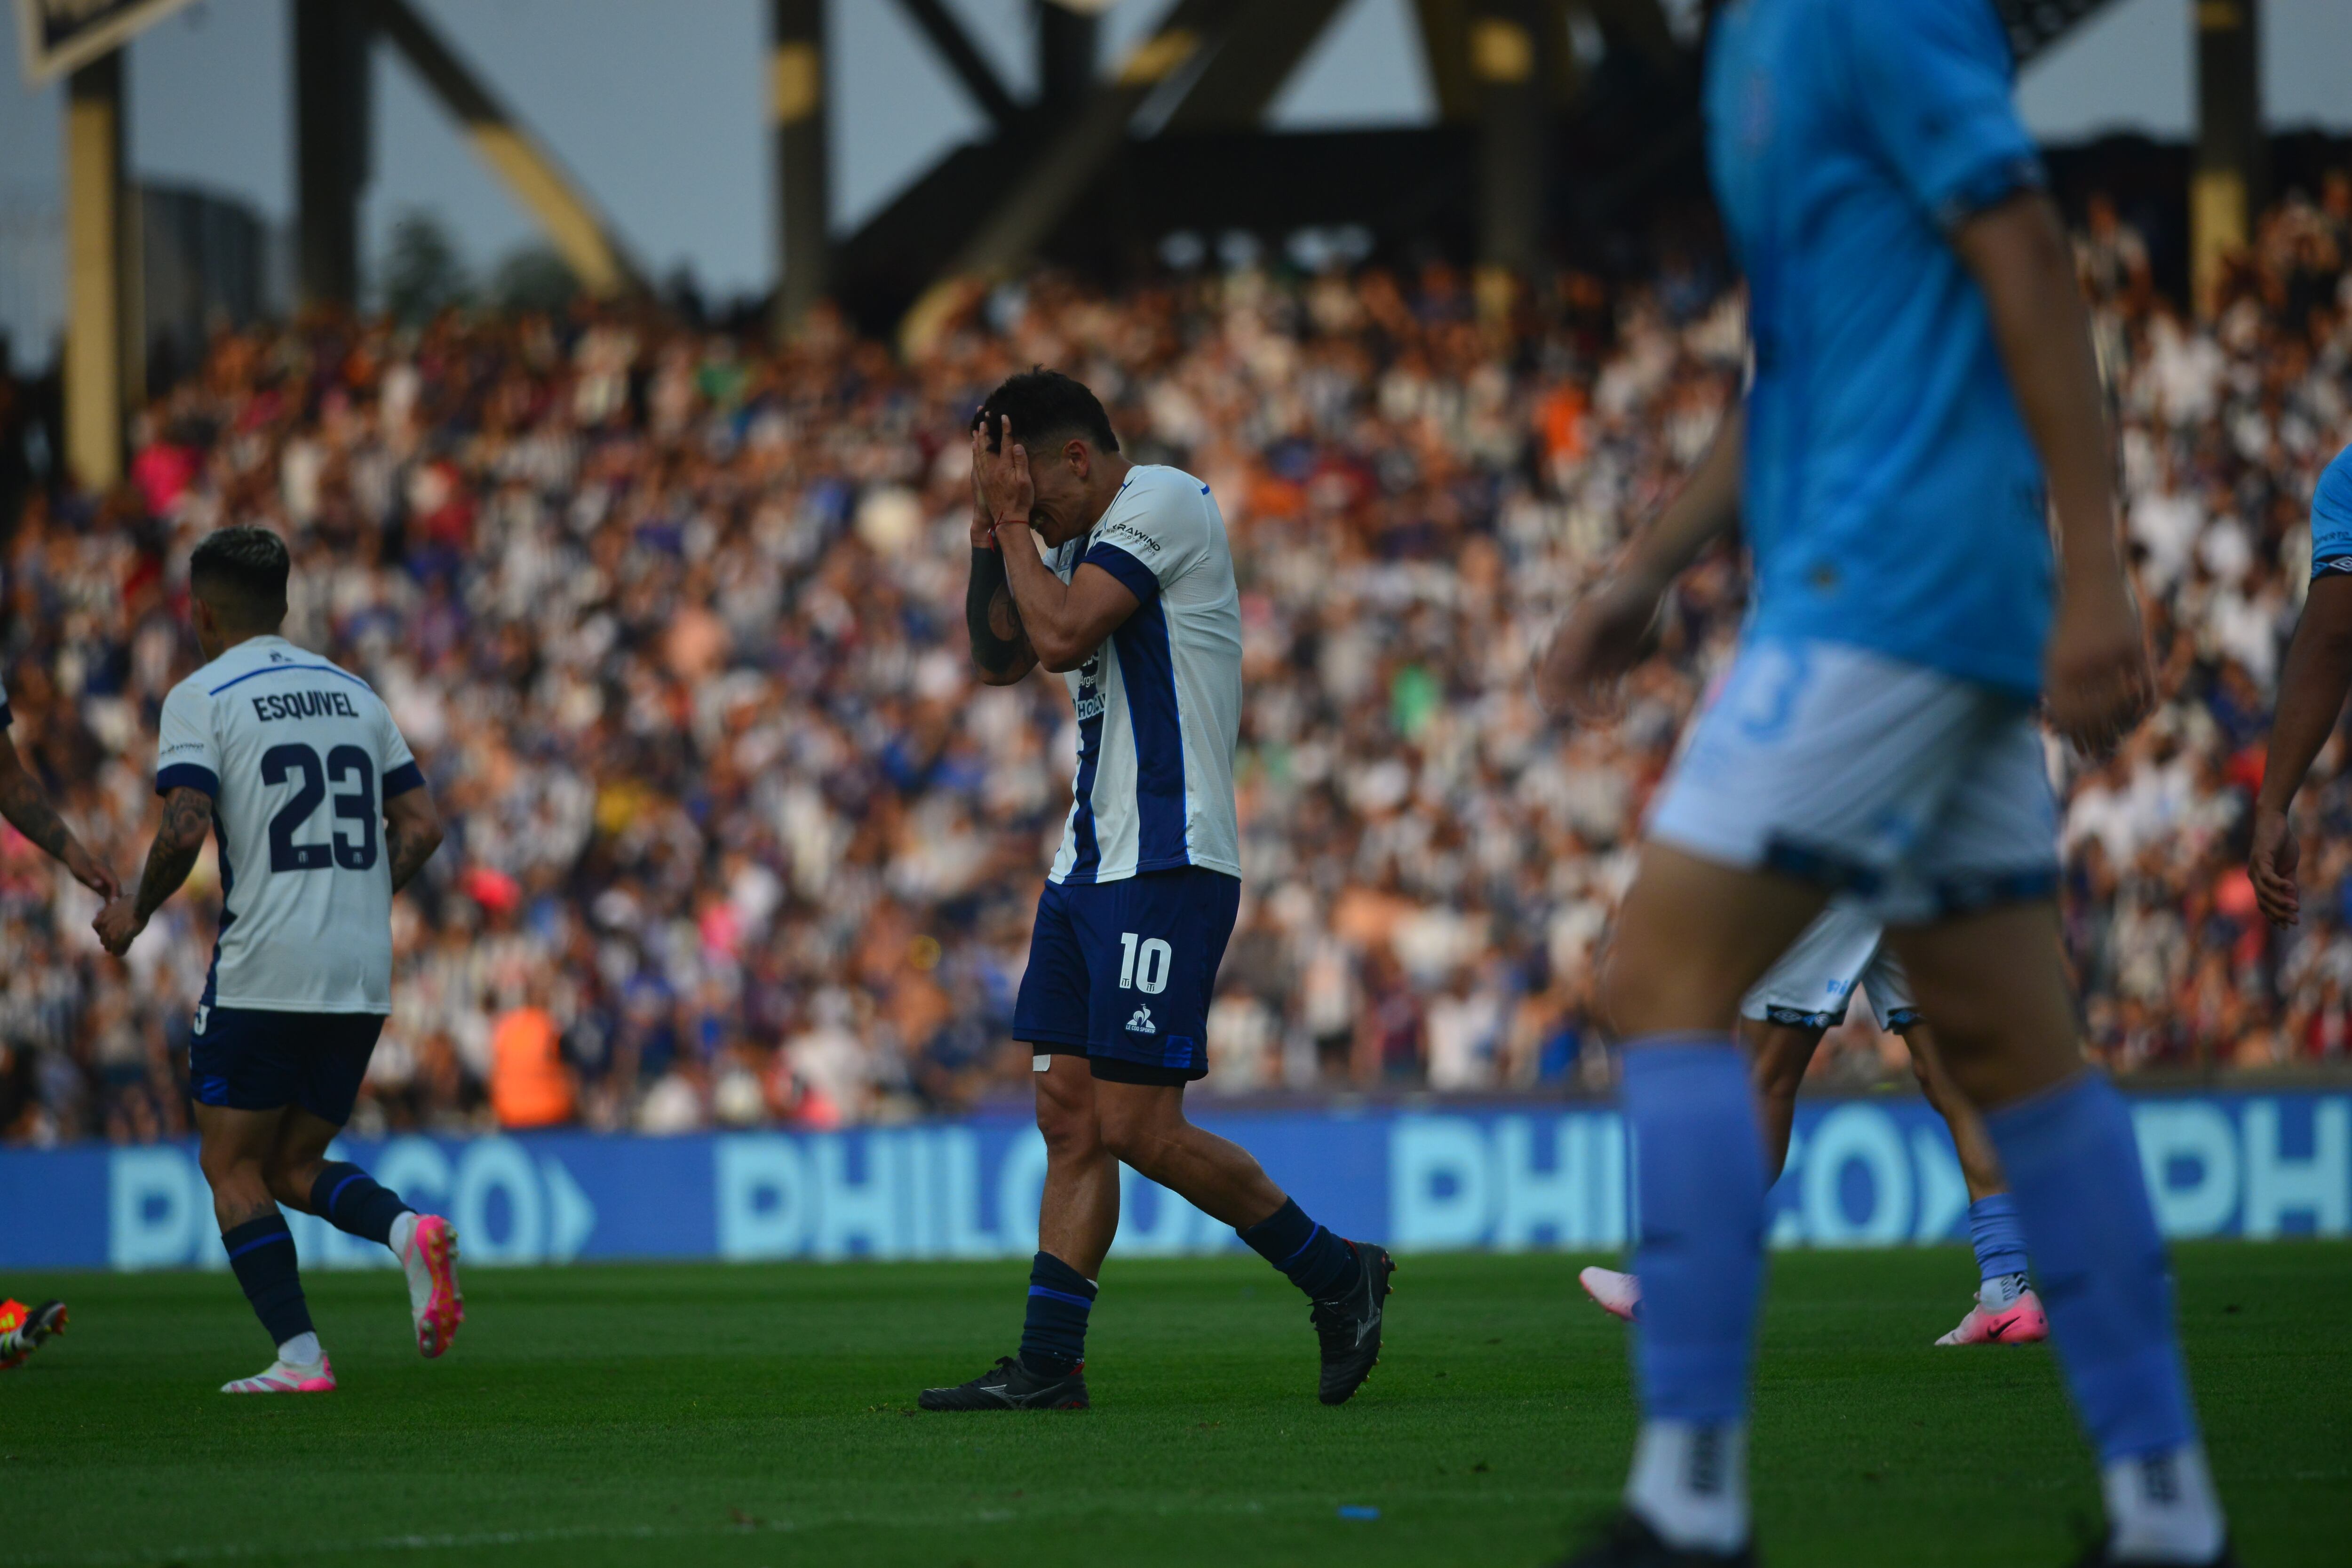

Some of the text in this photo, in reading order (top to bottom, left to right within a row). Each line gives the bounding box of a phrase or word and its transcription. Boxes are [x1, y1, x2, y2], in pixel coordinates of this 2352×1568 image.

[253, 690, 359, 722] ESQUIVEL
[261, 742, 378, 874] 23
[1119, 932, 1172, 995] 10
[1389, 1103, 1914, 1252] PHIO
